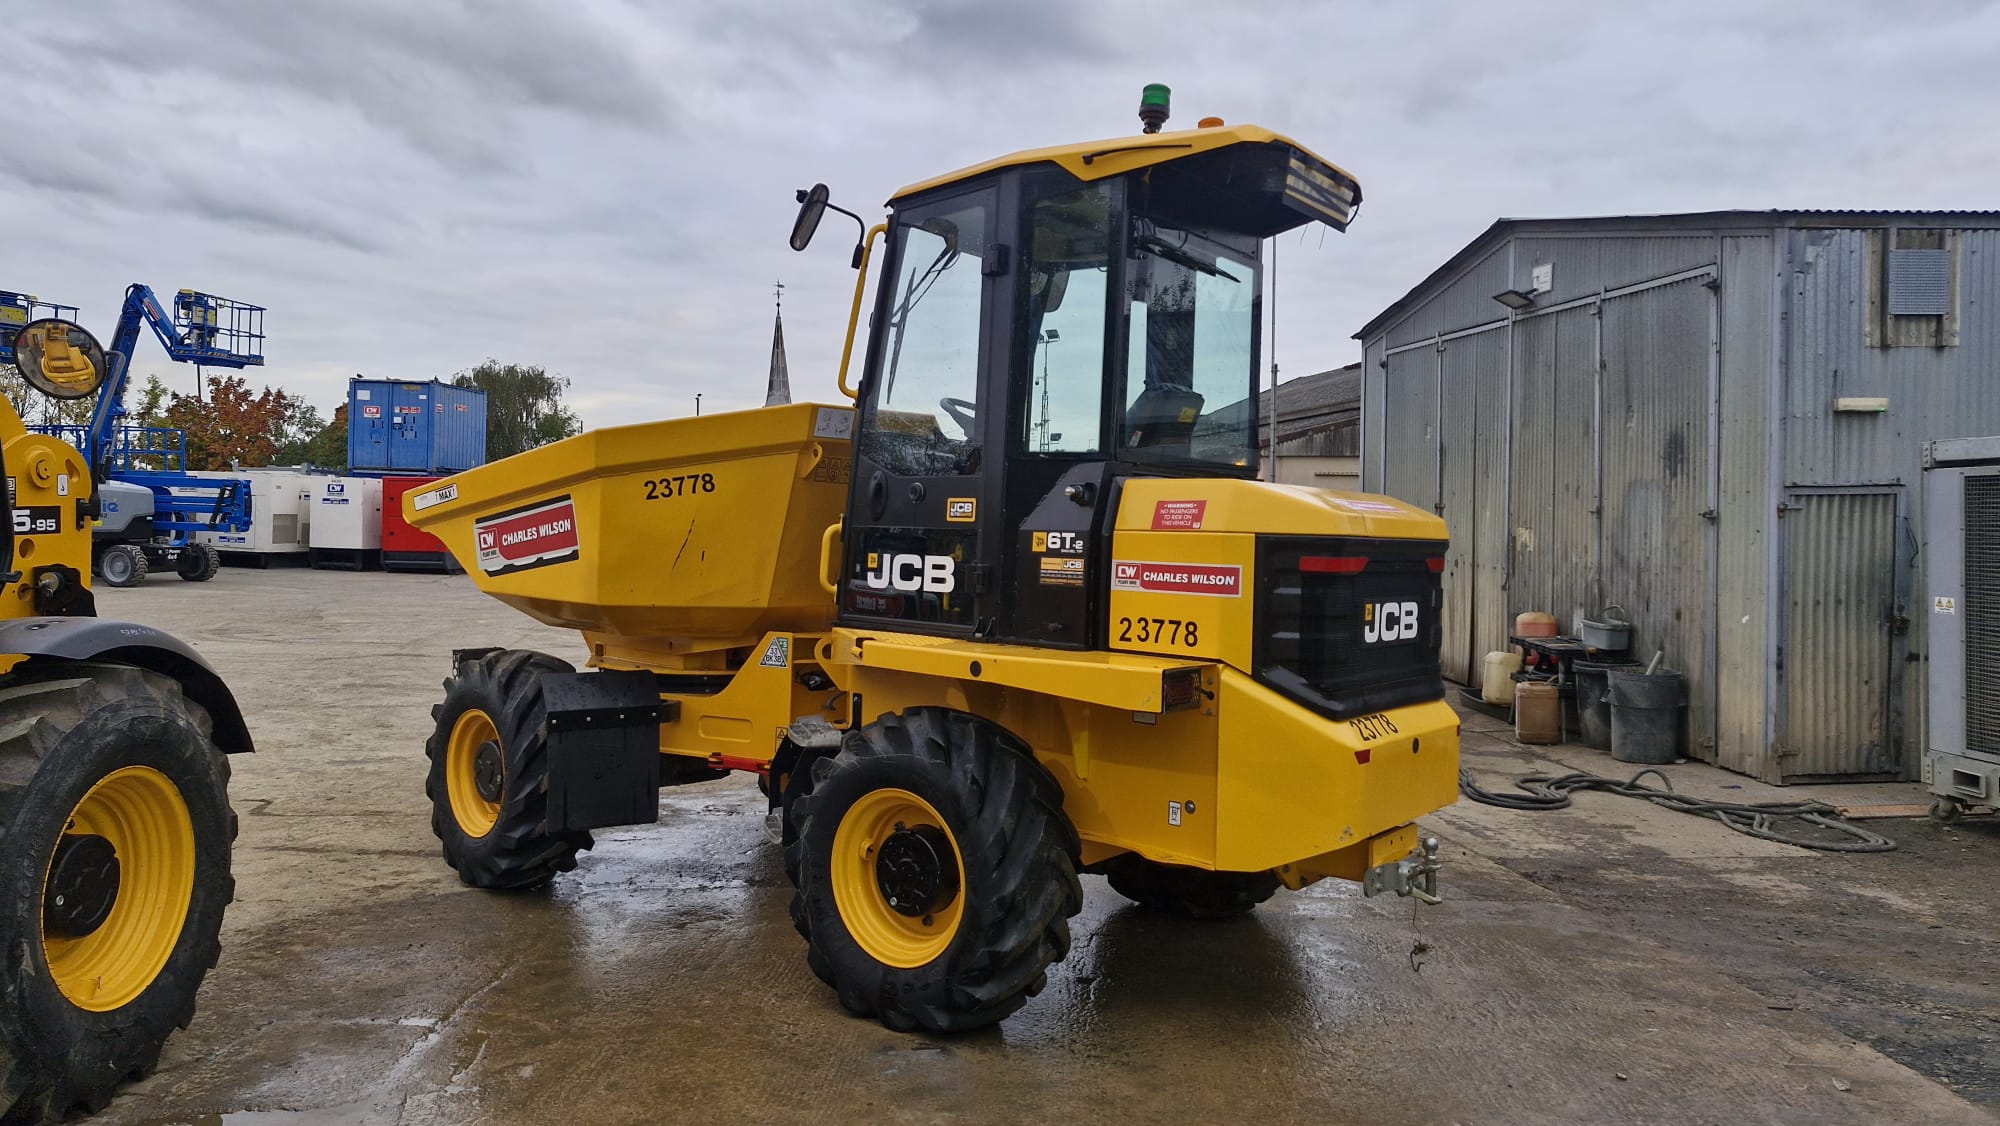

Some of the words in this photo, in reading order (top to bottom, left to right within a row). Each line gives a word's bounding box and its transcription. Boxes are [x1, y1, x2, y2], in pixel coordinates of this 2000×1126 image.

[438, 489, 453, 501] MAX
[644, 473, 716, 500] 23778
[950, 502, 973, 513] JCB
[502, 527, 538, 546] CHARLES
[539, 518, 572, 537] WILSON
[867, 553, 955, 593] JCB
[1063, 561, 1082, 569] JCB
[1143, 571, 1189, 583] CHARLES
[1191, 574, 1235, 586] WILSON
[1118, 617, 1198, 648] 23778
[1364, 601, 1419, 643] JCB
[1349, 712, 1399, 742] 23778
